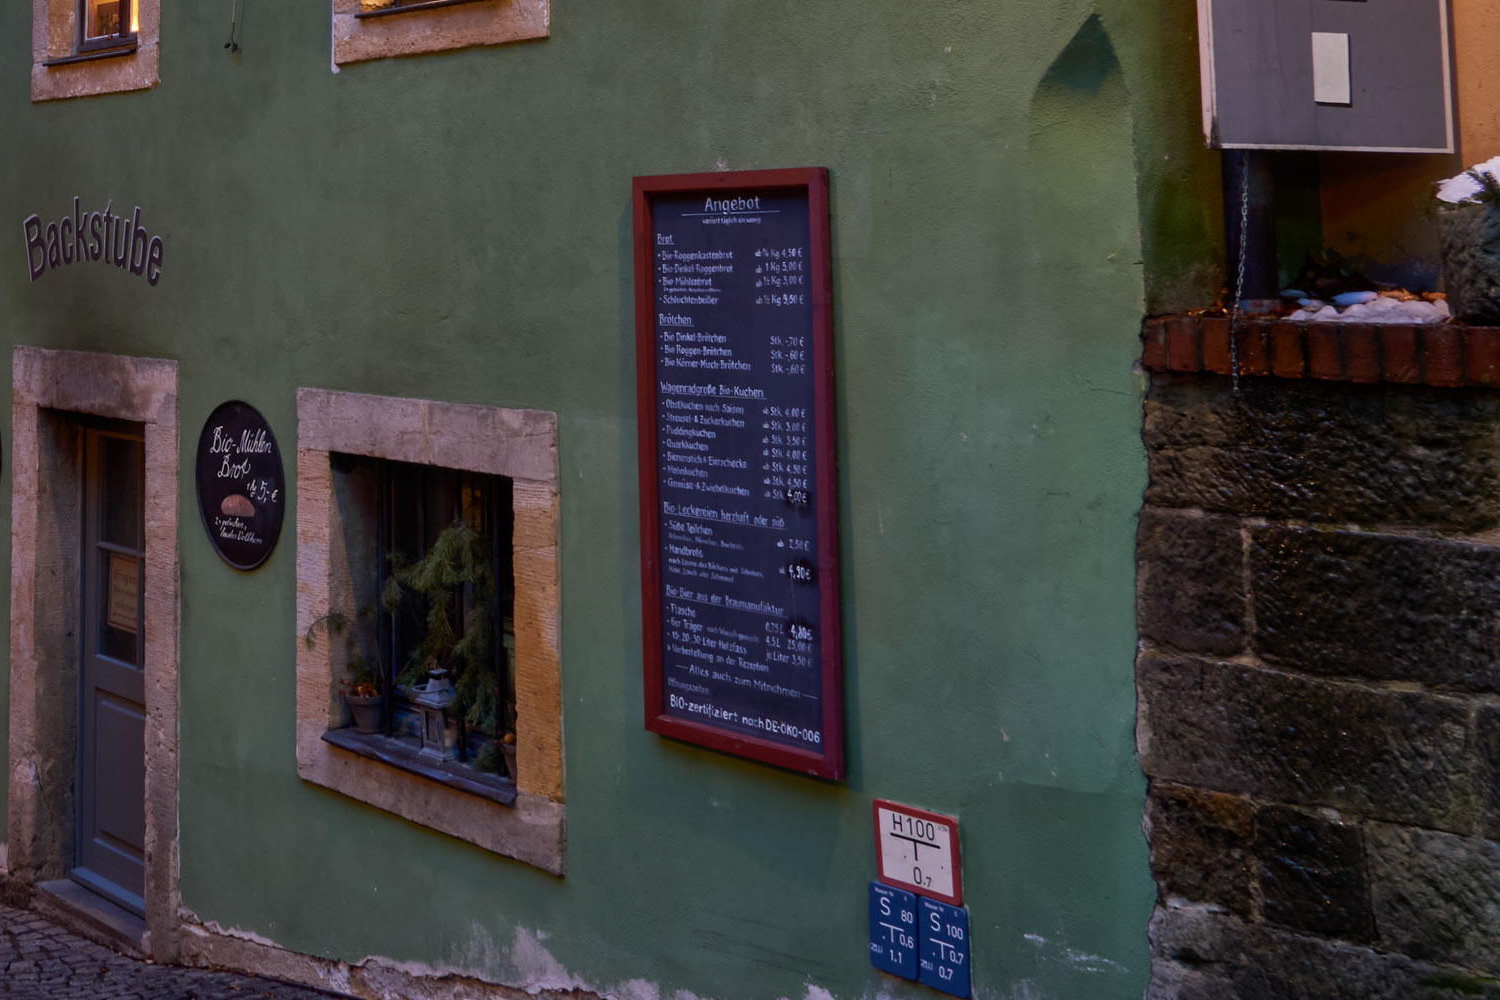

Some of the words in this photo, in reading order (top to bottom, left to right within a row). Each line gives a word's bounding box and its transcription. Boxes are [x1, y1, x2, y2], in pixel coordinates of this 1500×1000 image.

[705, 196, 761, 215] Angebot
[23, 196, 163, 287] Backstube
[657, 233, 672, 243] Brot
[771, 249, 780, 259] Kg
[771, 262, 780, 273] Kg
[771, 276, 780, 287] Kg
[771, 294, 781, 306] Kg
[659, 313, 692, 325] Brötchen
[799, 336, 804, 346] €
[800, 350, 804, 360] €
[800, 365, 805, 374] €
[719, 384, 764, 398] Bio-Kuchen
[722, 404, 744, 415] Saison
[801, 409, 805, 418] €
[802, 423, 806, 432] €
[210, 425, 272, 454] Bio-Mühlen
[802, 437, 806, 447] €
[802, 451, 807, 461] €
[217, 454, 251, 479] Brot
[803, 465, 807, 475] €
[803, 479, 807, 489] €
[271, 489, 278, 503] €
[664, 501, 718, 519] Bio-Leckereien
[720, 510, 749, 524] herzhaft
[754, 515, 768, 526] oder
[686, 523, 713, 536] Teilchen
[669, 544, 703, 558] Handbrote
[666, 584, 693, 599] Bio-Bier
[696, 593, 708, 601] aus
[711, 593, 722, 604] der
[725, 595, 785, 616] Braumanufaktur
[671, 603, 697, 618] Flasche
[671, 617, 681, 627] 6er
[683, 619, 703, 632] Träger
[773, 651, 789, 663] Liter
[689, 664, 709, 677] Alles
[712, 671, 731, 681] auch
[734, 677, 752, 687] zum
[753, 679, 800, 698] Mitnehmen
[670, 694, 738, 722] BIO-zertifiziert
[742, 715, 764, 729] nach
[765, 719, 820, 744] DE-ÖKO-006
[914, 867, 931, 888] 0.7
[880, 897, 891, 915] S
[901, 909, 913, 924] 80
[930, 912, 941, 931] S
[946, 924, 963, 940] 100
[899, 933, 914, 949] 0.6
[890, 949, 902, 964] 1.1
[949, 950, 964, 965] 0.7
[939, 966, 953, 980] 0.7
